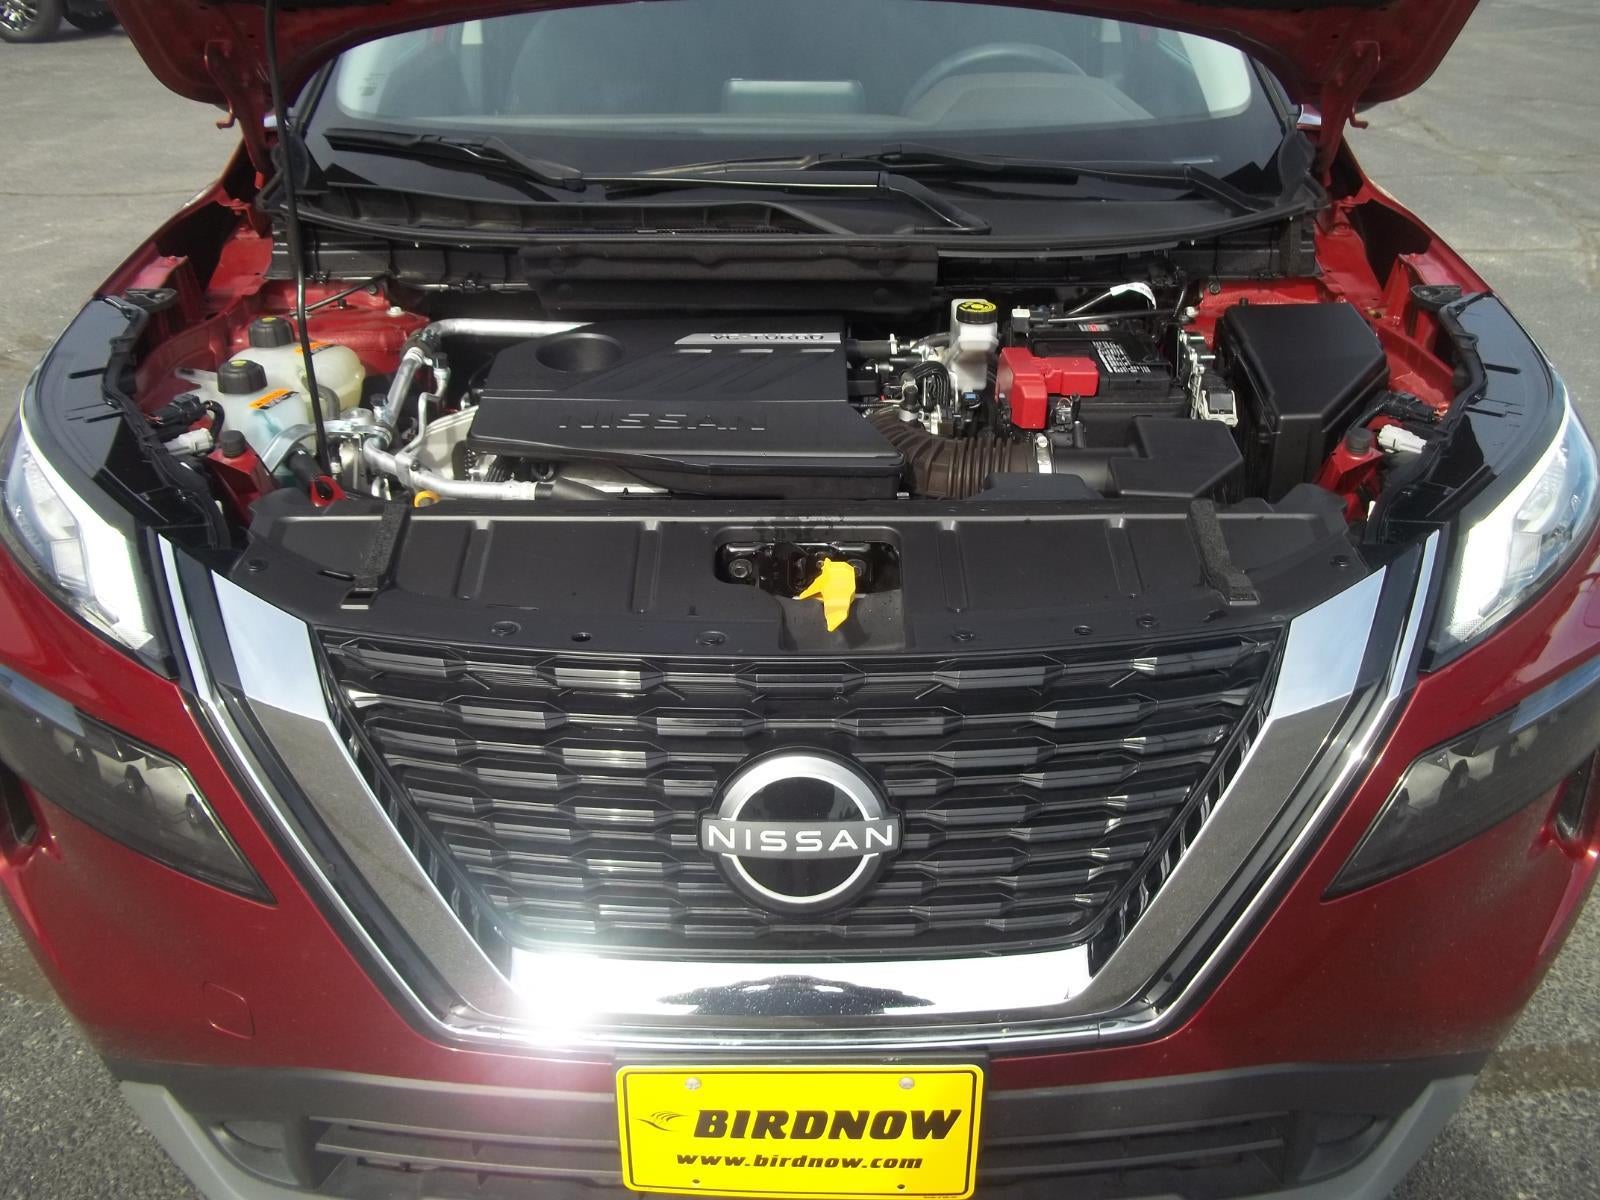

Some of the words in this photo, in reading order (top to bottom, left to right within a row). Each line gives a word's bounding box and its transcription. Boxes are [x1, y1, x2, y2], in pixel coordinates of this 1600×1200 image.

[558, 412, 767, 431] NISSAN
[708, 825, 893, 852] NISSAN
[693, 1108, 962, 1140] BIRDNOW
[676, 1153, 923, 1169] www.birdnow.com
